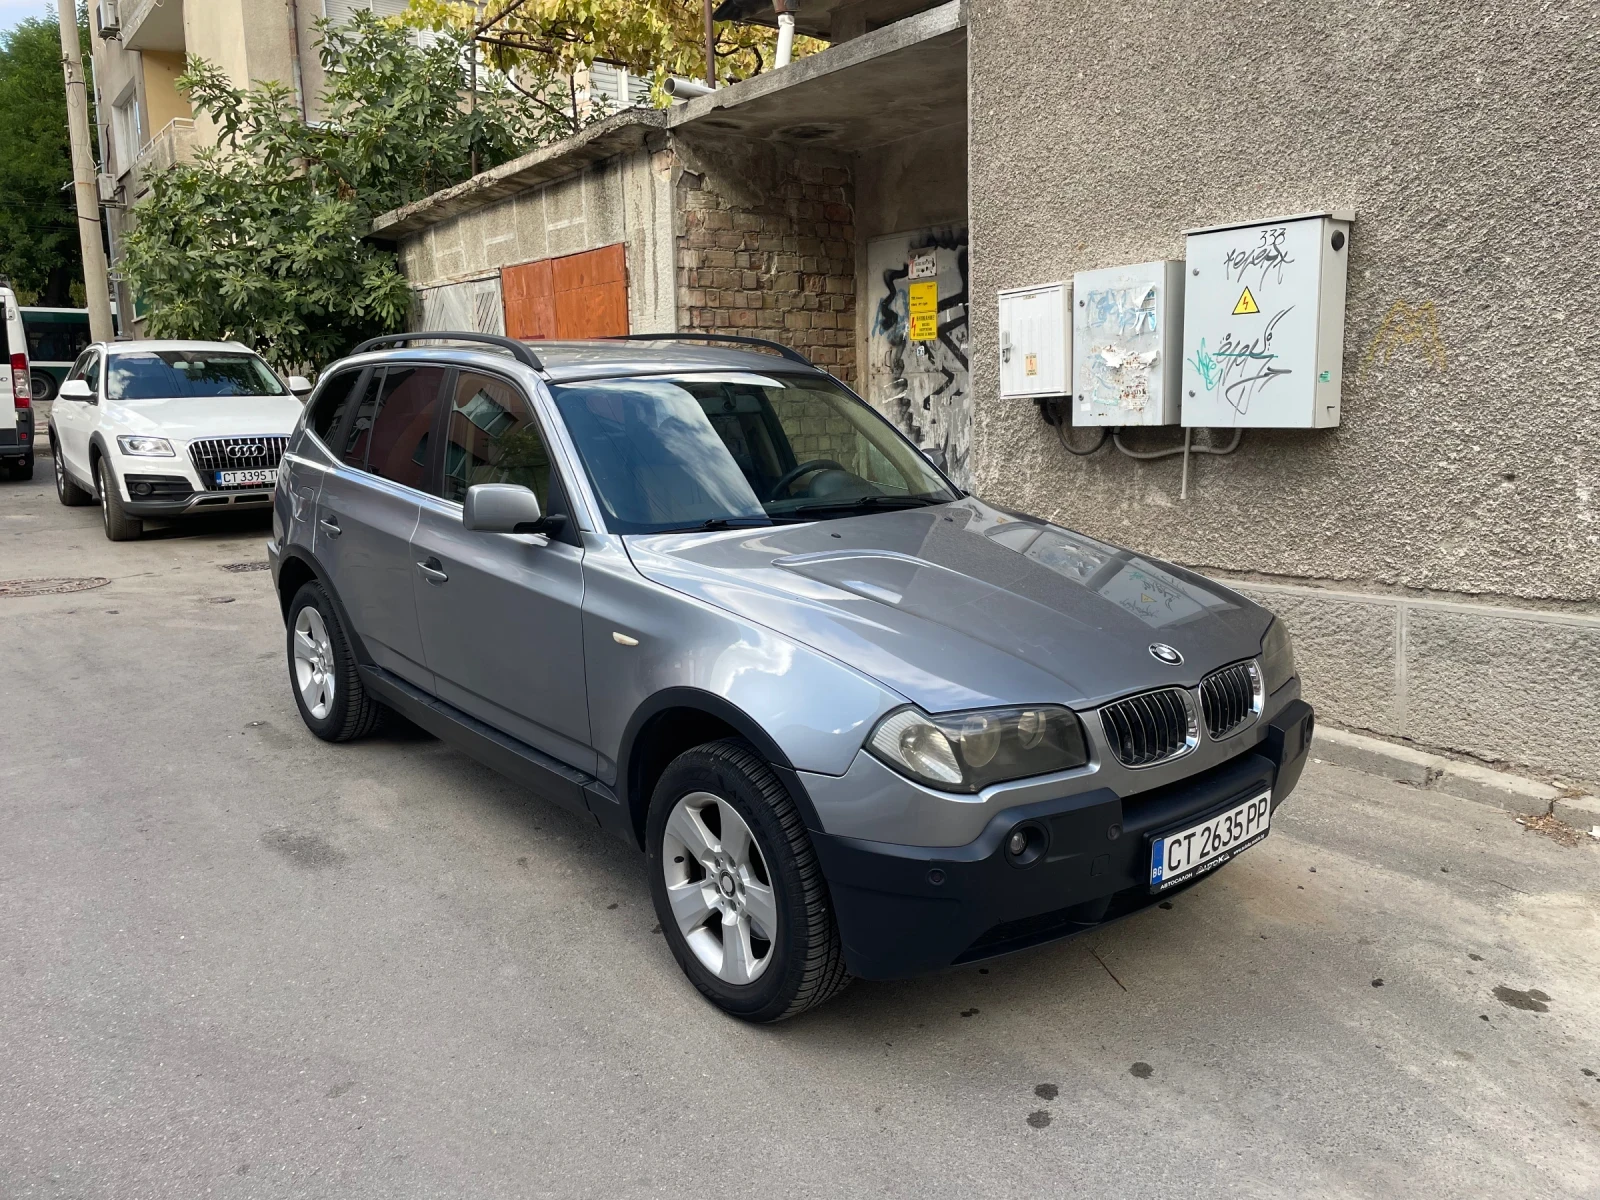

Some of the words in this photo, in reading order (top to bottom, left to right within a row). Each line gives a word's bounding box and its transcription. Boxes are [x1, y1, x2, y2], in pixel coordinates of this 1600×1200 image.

[223, 472, 238, 482] CT
[240, 470, 267, 481] 3395
[1168, 831, 1197, 872] CT
[1199, 808, 1244, 860] 2635
[1245, 796, 1268, 836] PP
[1152, 865, 1163, 879] BG
[1159, 872, 1193, 890] АВТОСАЛОН
